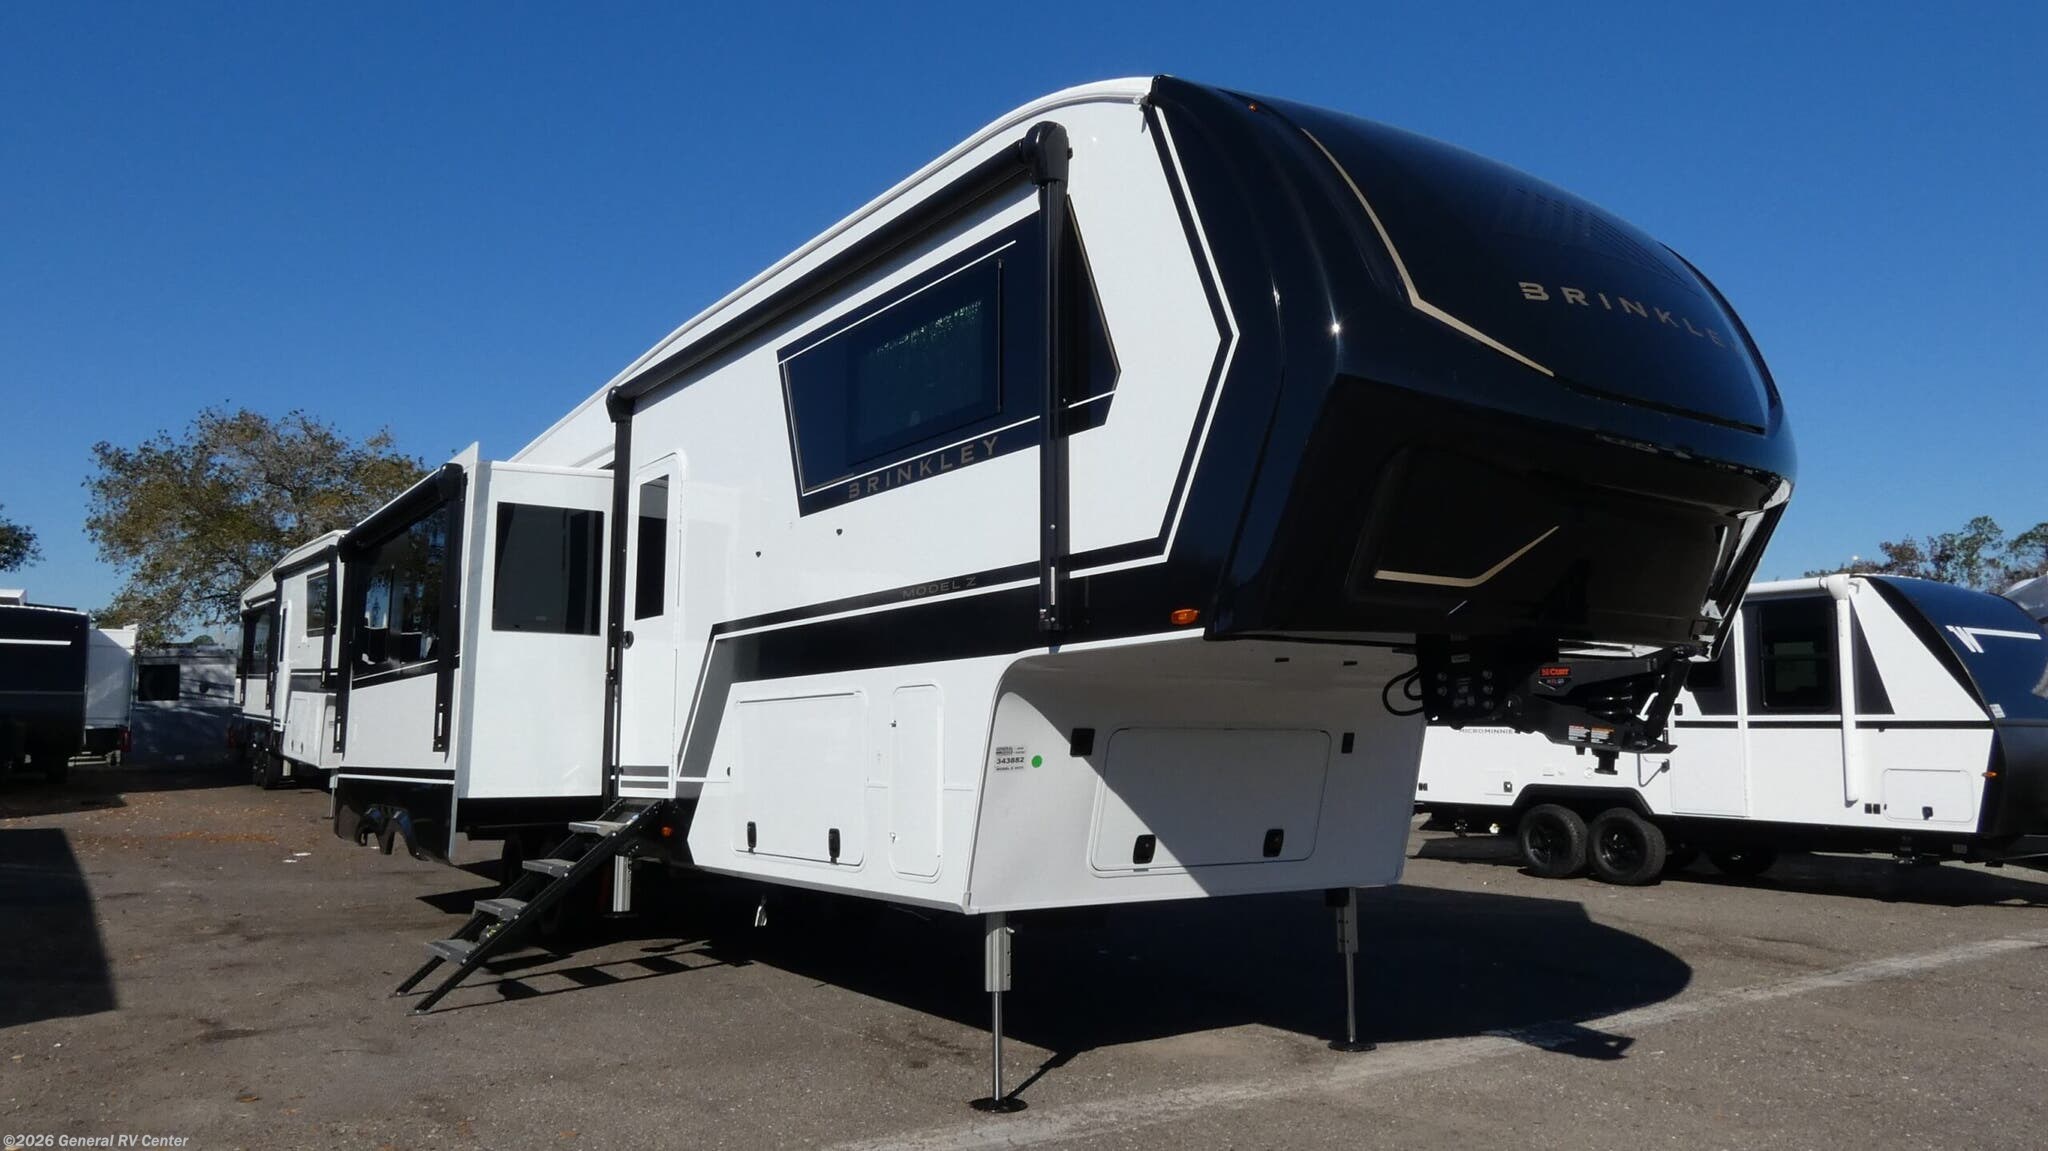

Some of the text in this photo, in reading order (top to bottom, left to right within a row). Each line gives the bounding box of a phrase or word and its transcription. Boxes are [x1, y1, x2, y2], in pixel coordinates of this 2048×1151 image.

[1518, 281, 1737, 352] BRINKLE
[848, 436, 999, 499] BRINKLEY
[902, 576, 977, 600] MODEL Z
